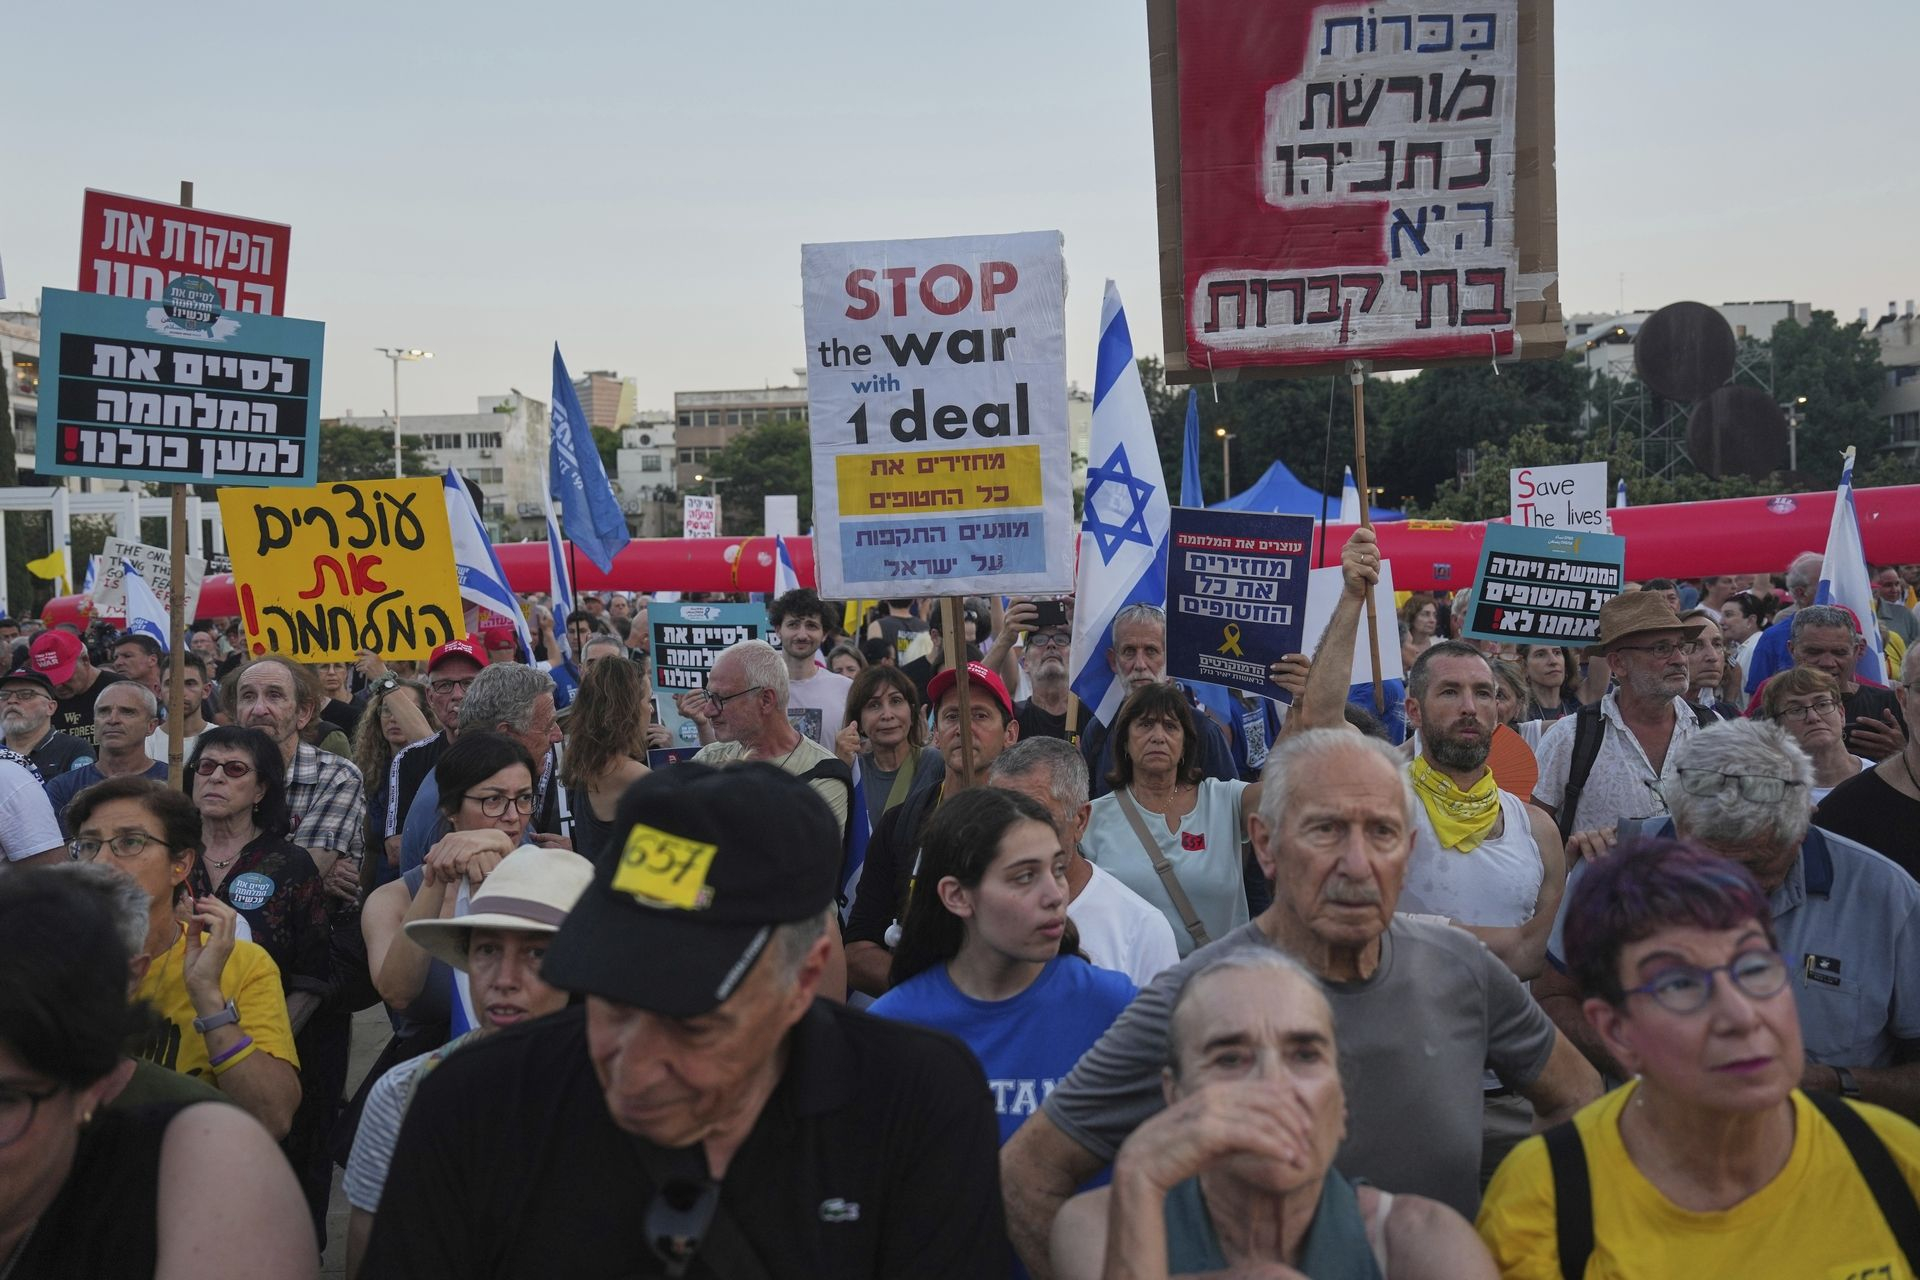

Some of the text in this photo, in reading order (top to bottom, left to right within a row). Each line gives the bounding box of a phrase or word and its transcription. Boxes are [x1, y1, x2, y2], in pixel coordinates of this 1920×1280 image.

[1276, 138, 1492, 196] נתניהו
[101, 208, 273, 276] הפקרת את
[1390, 202, 1493, 259] היא
[171, 287, 215, 302] לסיים את
[845, 261, 1018, 320] STOP
[172, 297, 212, 311] המלחמה
[173, 307, 210, 322] עכשיו!
[1204, 267, 1511, 344] בתי קברות
[818, 327, 1016, 367] the war
[92, 343, 293, 393] לסיים את
[851, 373, 900, 394] with
[96, 388, 278, 433] המלחמה
[846, 382, 1030, 444] 1 deal
[64, 426, 299, 478] למען כולנו!
[870, 453, 1005, 477] מחזירים את
[1518, 470, 1575, 498] Save
[869, 485, 1010, 509] כל החטופים
[1517, 500, 1602, 527] The lives
[855, 521, 1029, 548] מונעים התקפות
[1178, 534, 1302, 552] עוצרים את המלחמה
[115, 544, 171, 562] THE ONL
[110, 556, 171, 576] THNG THI
[299, 552, 387, 600] את
[884, 554, 1003, 577] על ישראל
[1190, 554, 1286, 578] מחזירים
[1490, 557, 1618, 586] הממשלה ויתרה
[1200, 575, 1273, 599] את כל
[1485, 581, 1586, 610] החטופים
[240, 582, 455, 656] המלחמה!
[1183, 597, 1287, 623] החטופים
[1491, 607, 1600, 637] אנחנו לא!
[664, 626, 688, 643] את
[692, 626, 748, 646] לסיים
[658, 667, 702, 688] כולנו!
[1200, 656, 1265, 675] הדמוקרטים
[1200, 667, 1264, 685] בראשות יאיר גולן
[64, 712, 81, 724] WF
[69, 724, 95, 737] FORES
[622, 834, 705, 886] 657
[235, 887, 267, 897] המלחמה
[237, 880, 270, 891] לסיים את
[234, 894, 264, 904] עכשיו!
